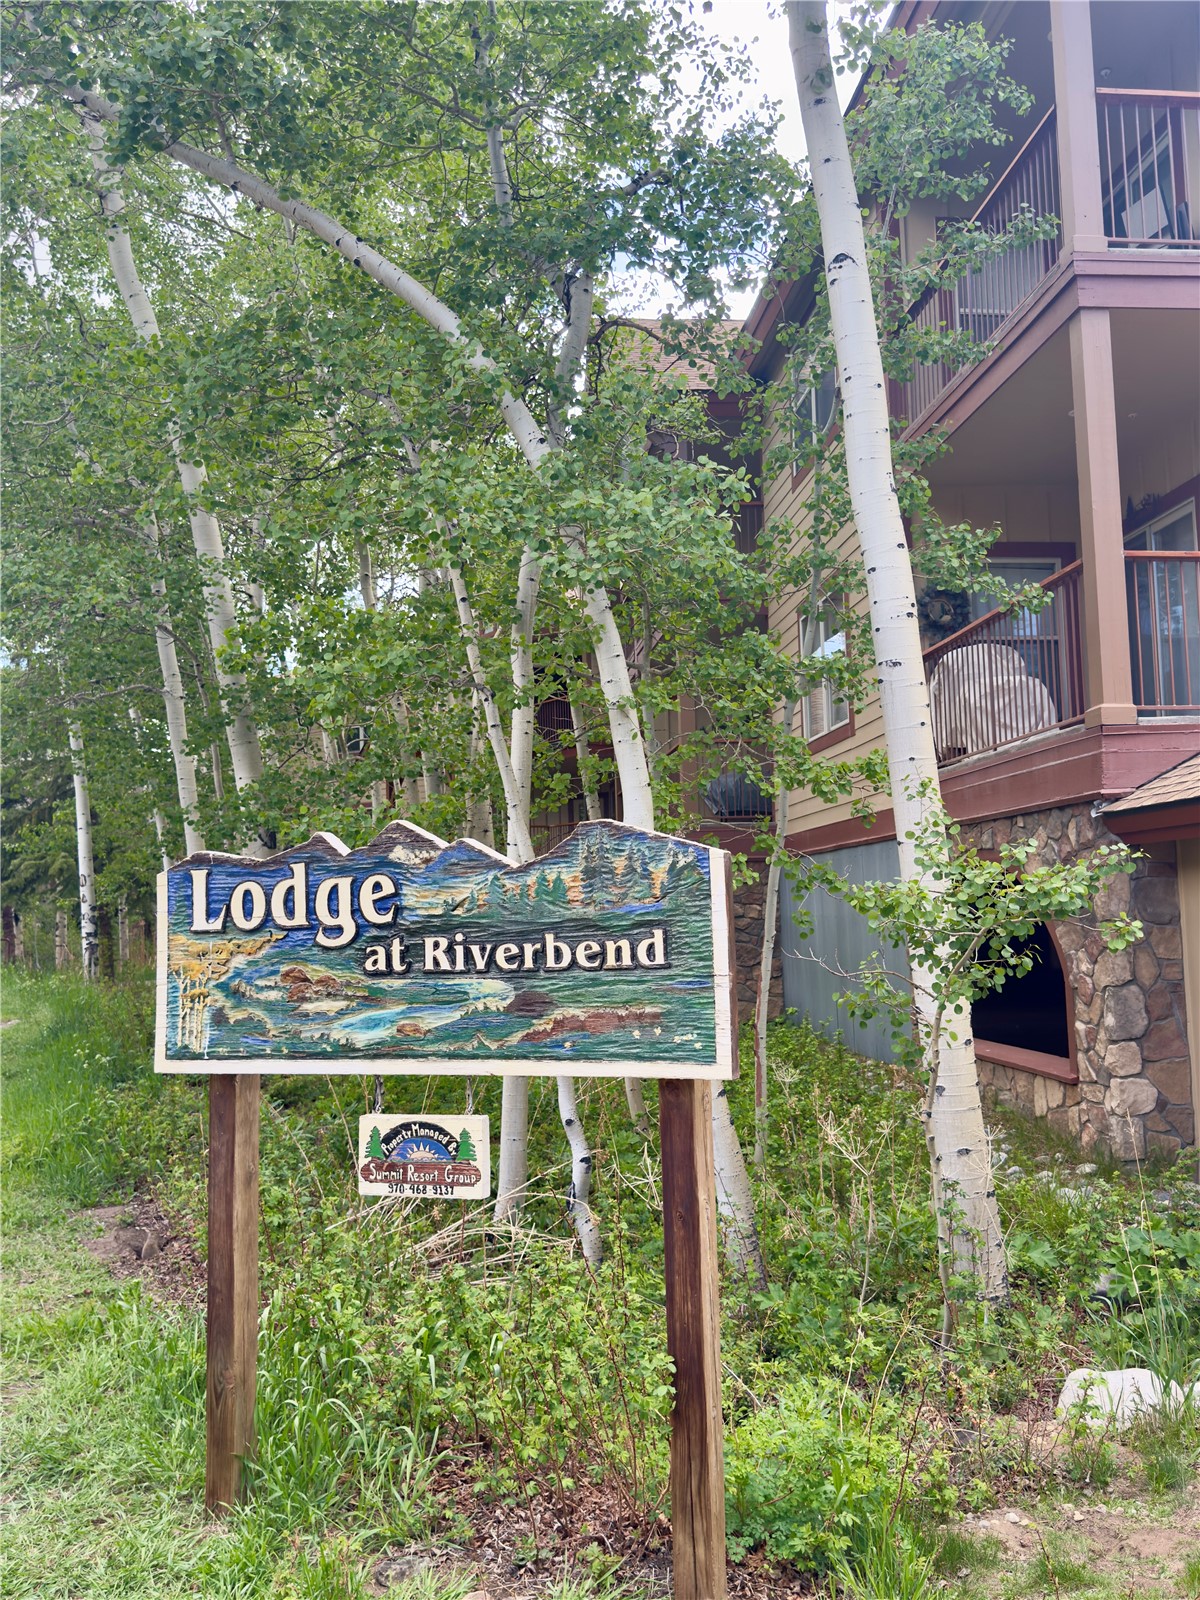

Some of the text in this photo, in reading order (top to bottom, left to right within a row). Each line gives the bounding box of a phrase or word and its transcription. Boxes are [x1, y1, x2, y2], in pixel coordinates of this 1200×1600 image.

[189, 862, 397, 948] Lodge
[363, 929, 667, 971] at Riverbend
[380, 1129, 412, 1156] Property
[411, 1123, 450, 1145] Managed
[369, 1163, 477, 1183] Summit Resort Group
